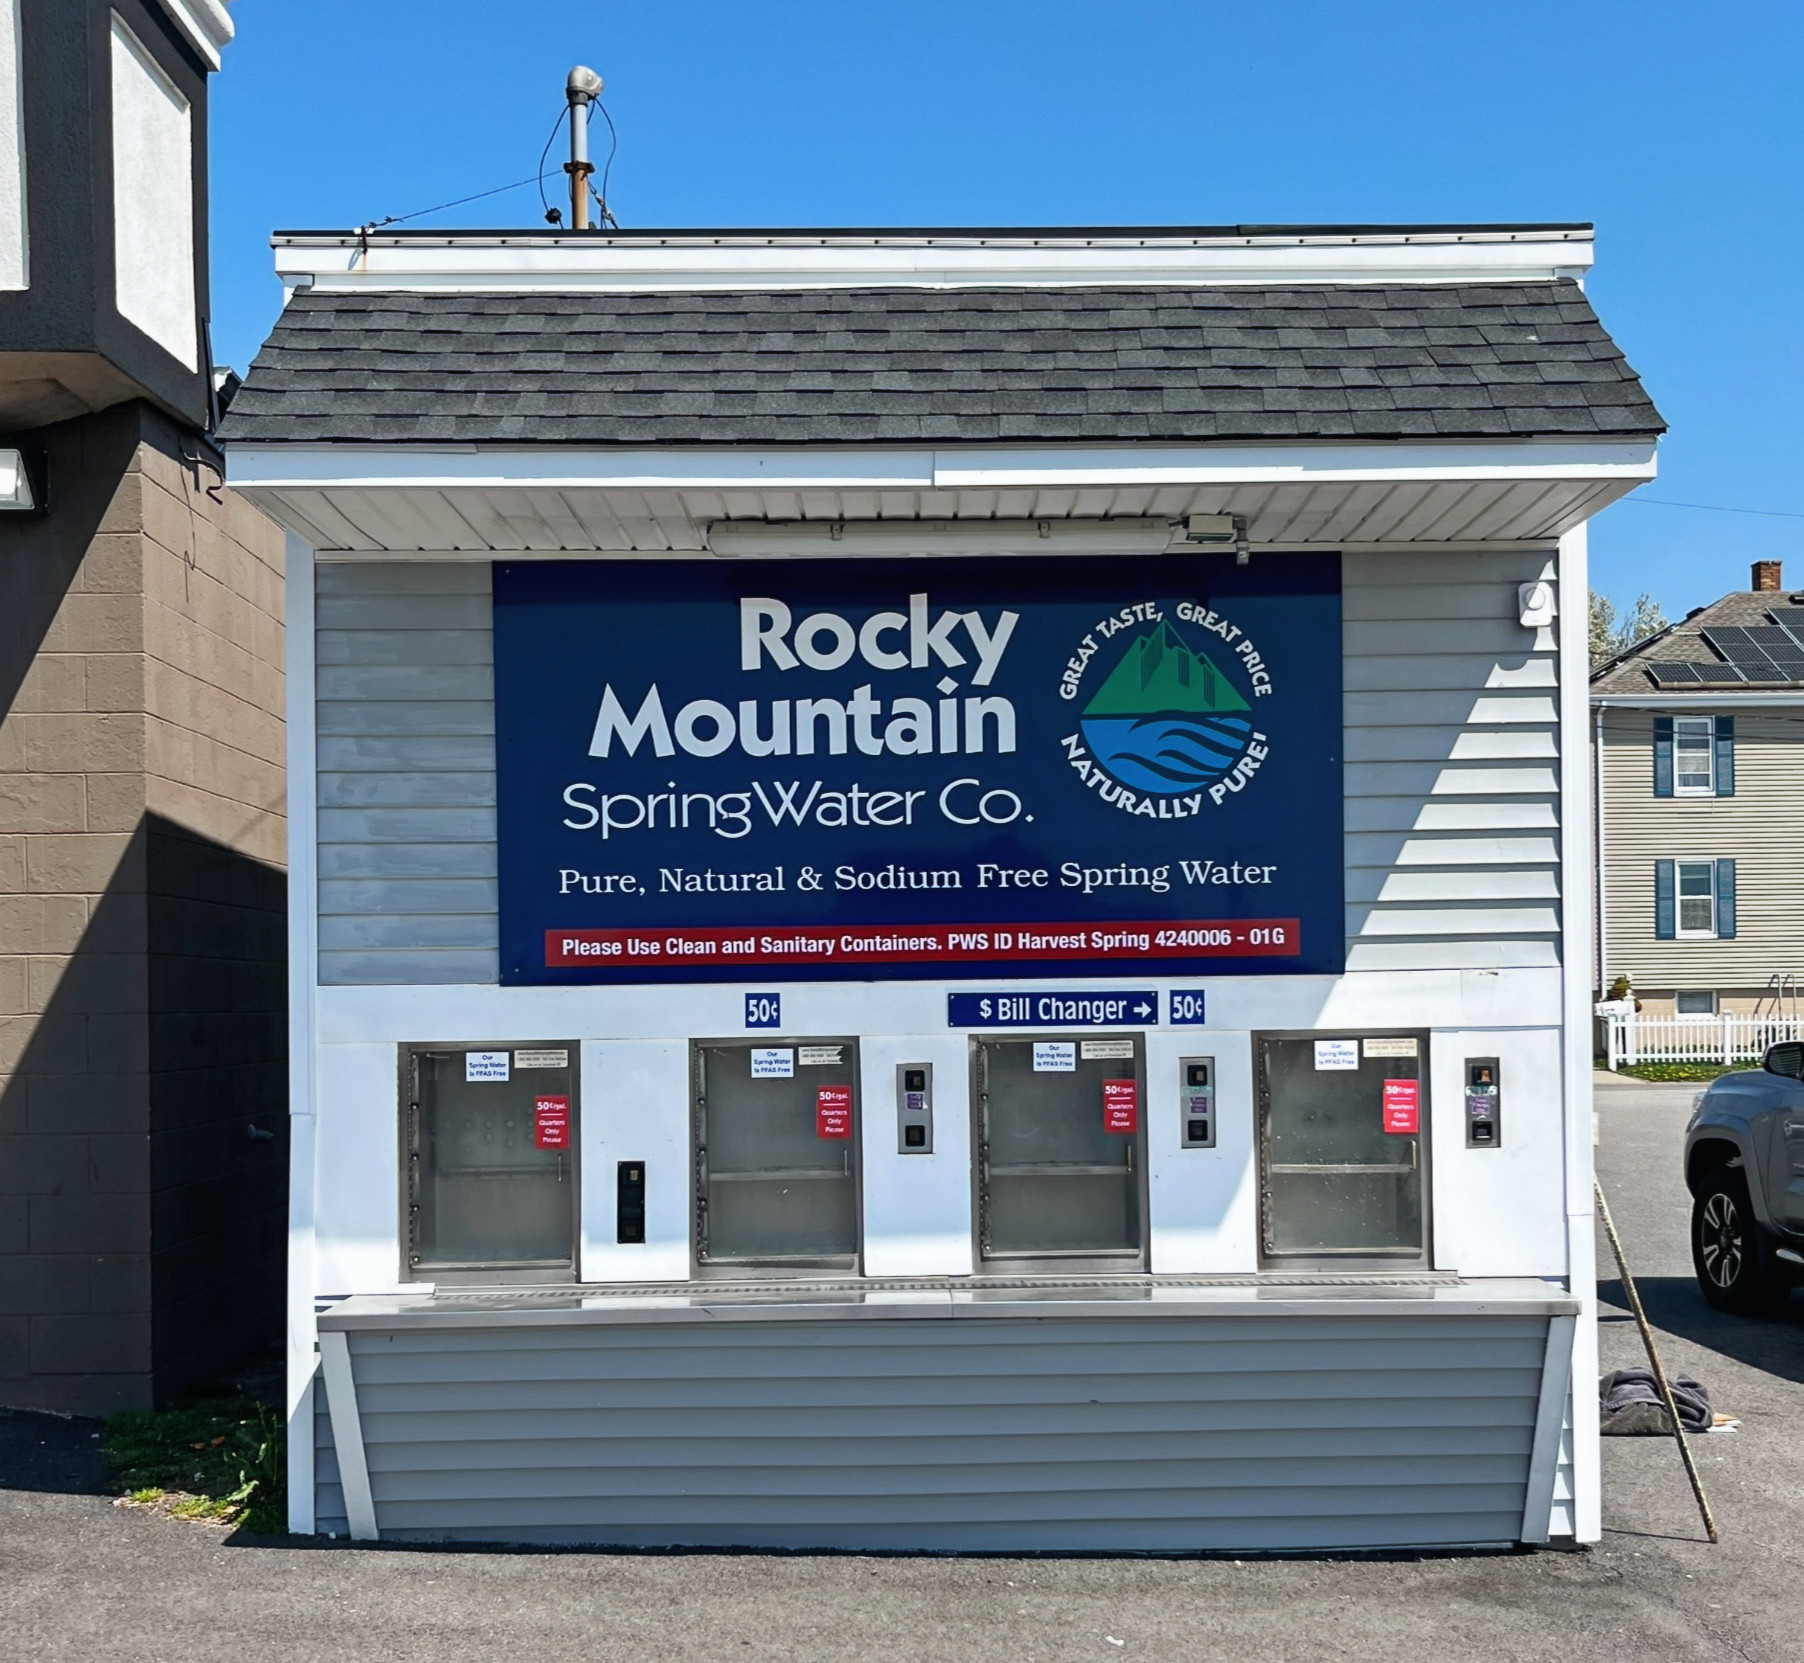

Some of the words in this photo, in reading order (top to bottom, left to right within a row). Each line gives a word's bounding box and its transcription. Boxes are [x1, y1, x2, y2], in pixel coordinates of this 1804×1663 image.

[739, 592, 1020, 686] Rocky
[1060, 635, 1098, 700] GREAT
[1096, 602, 1163, 639] TASTE,
[1176, 602, 1242, 643] GREAT
[1235, 640, 1272, 697] PRICE
[588, 676, 1016, 757] Mountain
[1061, 734, 1202, 819] NATURALLY
[939, 778, 1034, 825] Co.
[559, 869, 646, 896] Pure,
[659, 866, 786, 893] Natural
[796, 866, 824, 891] &
[834, 864, 963, 891] Sodium
[976, 863, 1049, 888] Free
[1060, 862, 1171, 894] Spring
[1178, 860, 1278, 885] Water
[562, 938, 623, 956] Please
[627, 938, 661, 955] Use
[665, 937, 717, 955] Clean
[721, 936, 756, 954] and
[760, 936, 836, 956] Sanitary
[840, 934, 943, 952] Containers.
[948, 933, 989, 950] PWS
[994, 933, 1013, 950] ID
[1018, 932, 1087, 949] Harvest
[1091, 930, 1150, 952] Spring
[1154, 929, 1232, 947] 4240006
[1249, 927, 1285, 945] 01G
[747, 998, 778, 1023] 50¢
[979, 998, 992, 1020] $
[998, 997, 1030, 1021] Bill
[1038, 997, 1127, 1024] Changer
[1172, 995, 1203, 1020] 50¢
